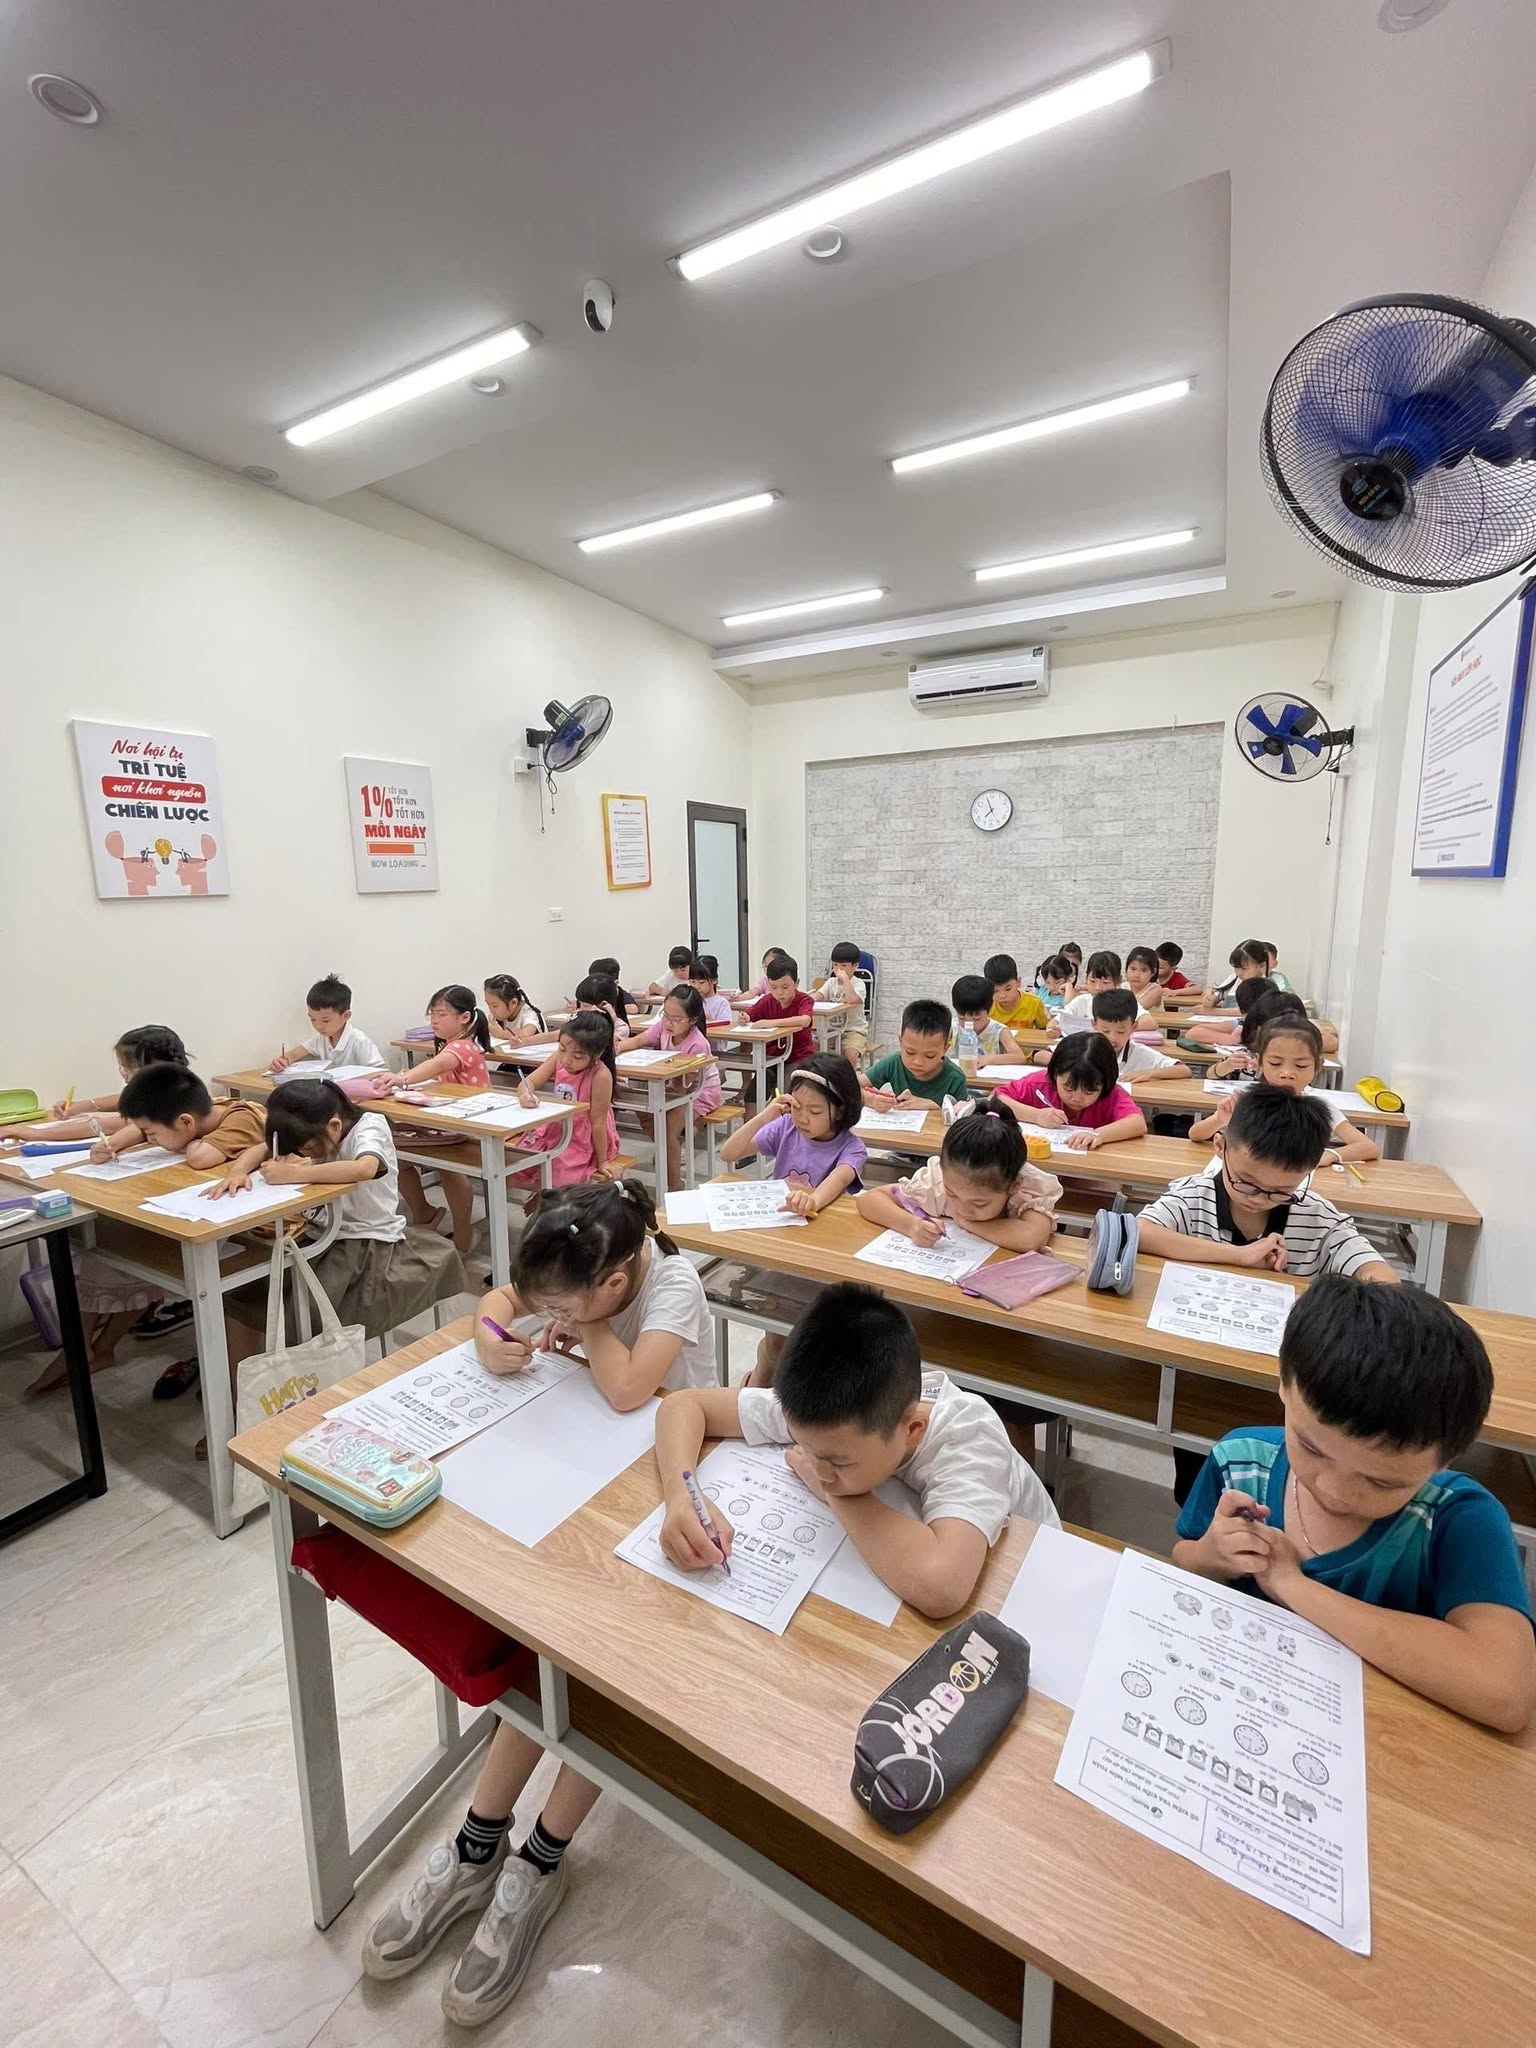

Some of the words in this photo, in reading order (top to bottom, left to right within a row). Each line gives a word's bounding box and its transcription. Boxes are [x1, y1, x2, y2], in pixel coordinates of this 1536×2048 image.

[143, 742, 167, 760] hội
[169, 746, 184, 762] tụ
[154, 762, 187, 781] TUỆ
[167, 786, 202, 802] nguồn
[361, 785, 393, 818] 1%
[105, 801, 159, 820] CHIẾN
[164, 808, 210, 824] LƯỢC
[395, 806, 410, 820] TỐT
[411, 810, 425, 820] HƠN
[364, 820, 391, 838] MỖI
[393, 824, 427, 839] NGÀY
[371, 859, 387, 868] NOW
